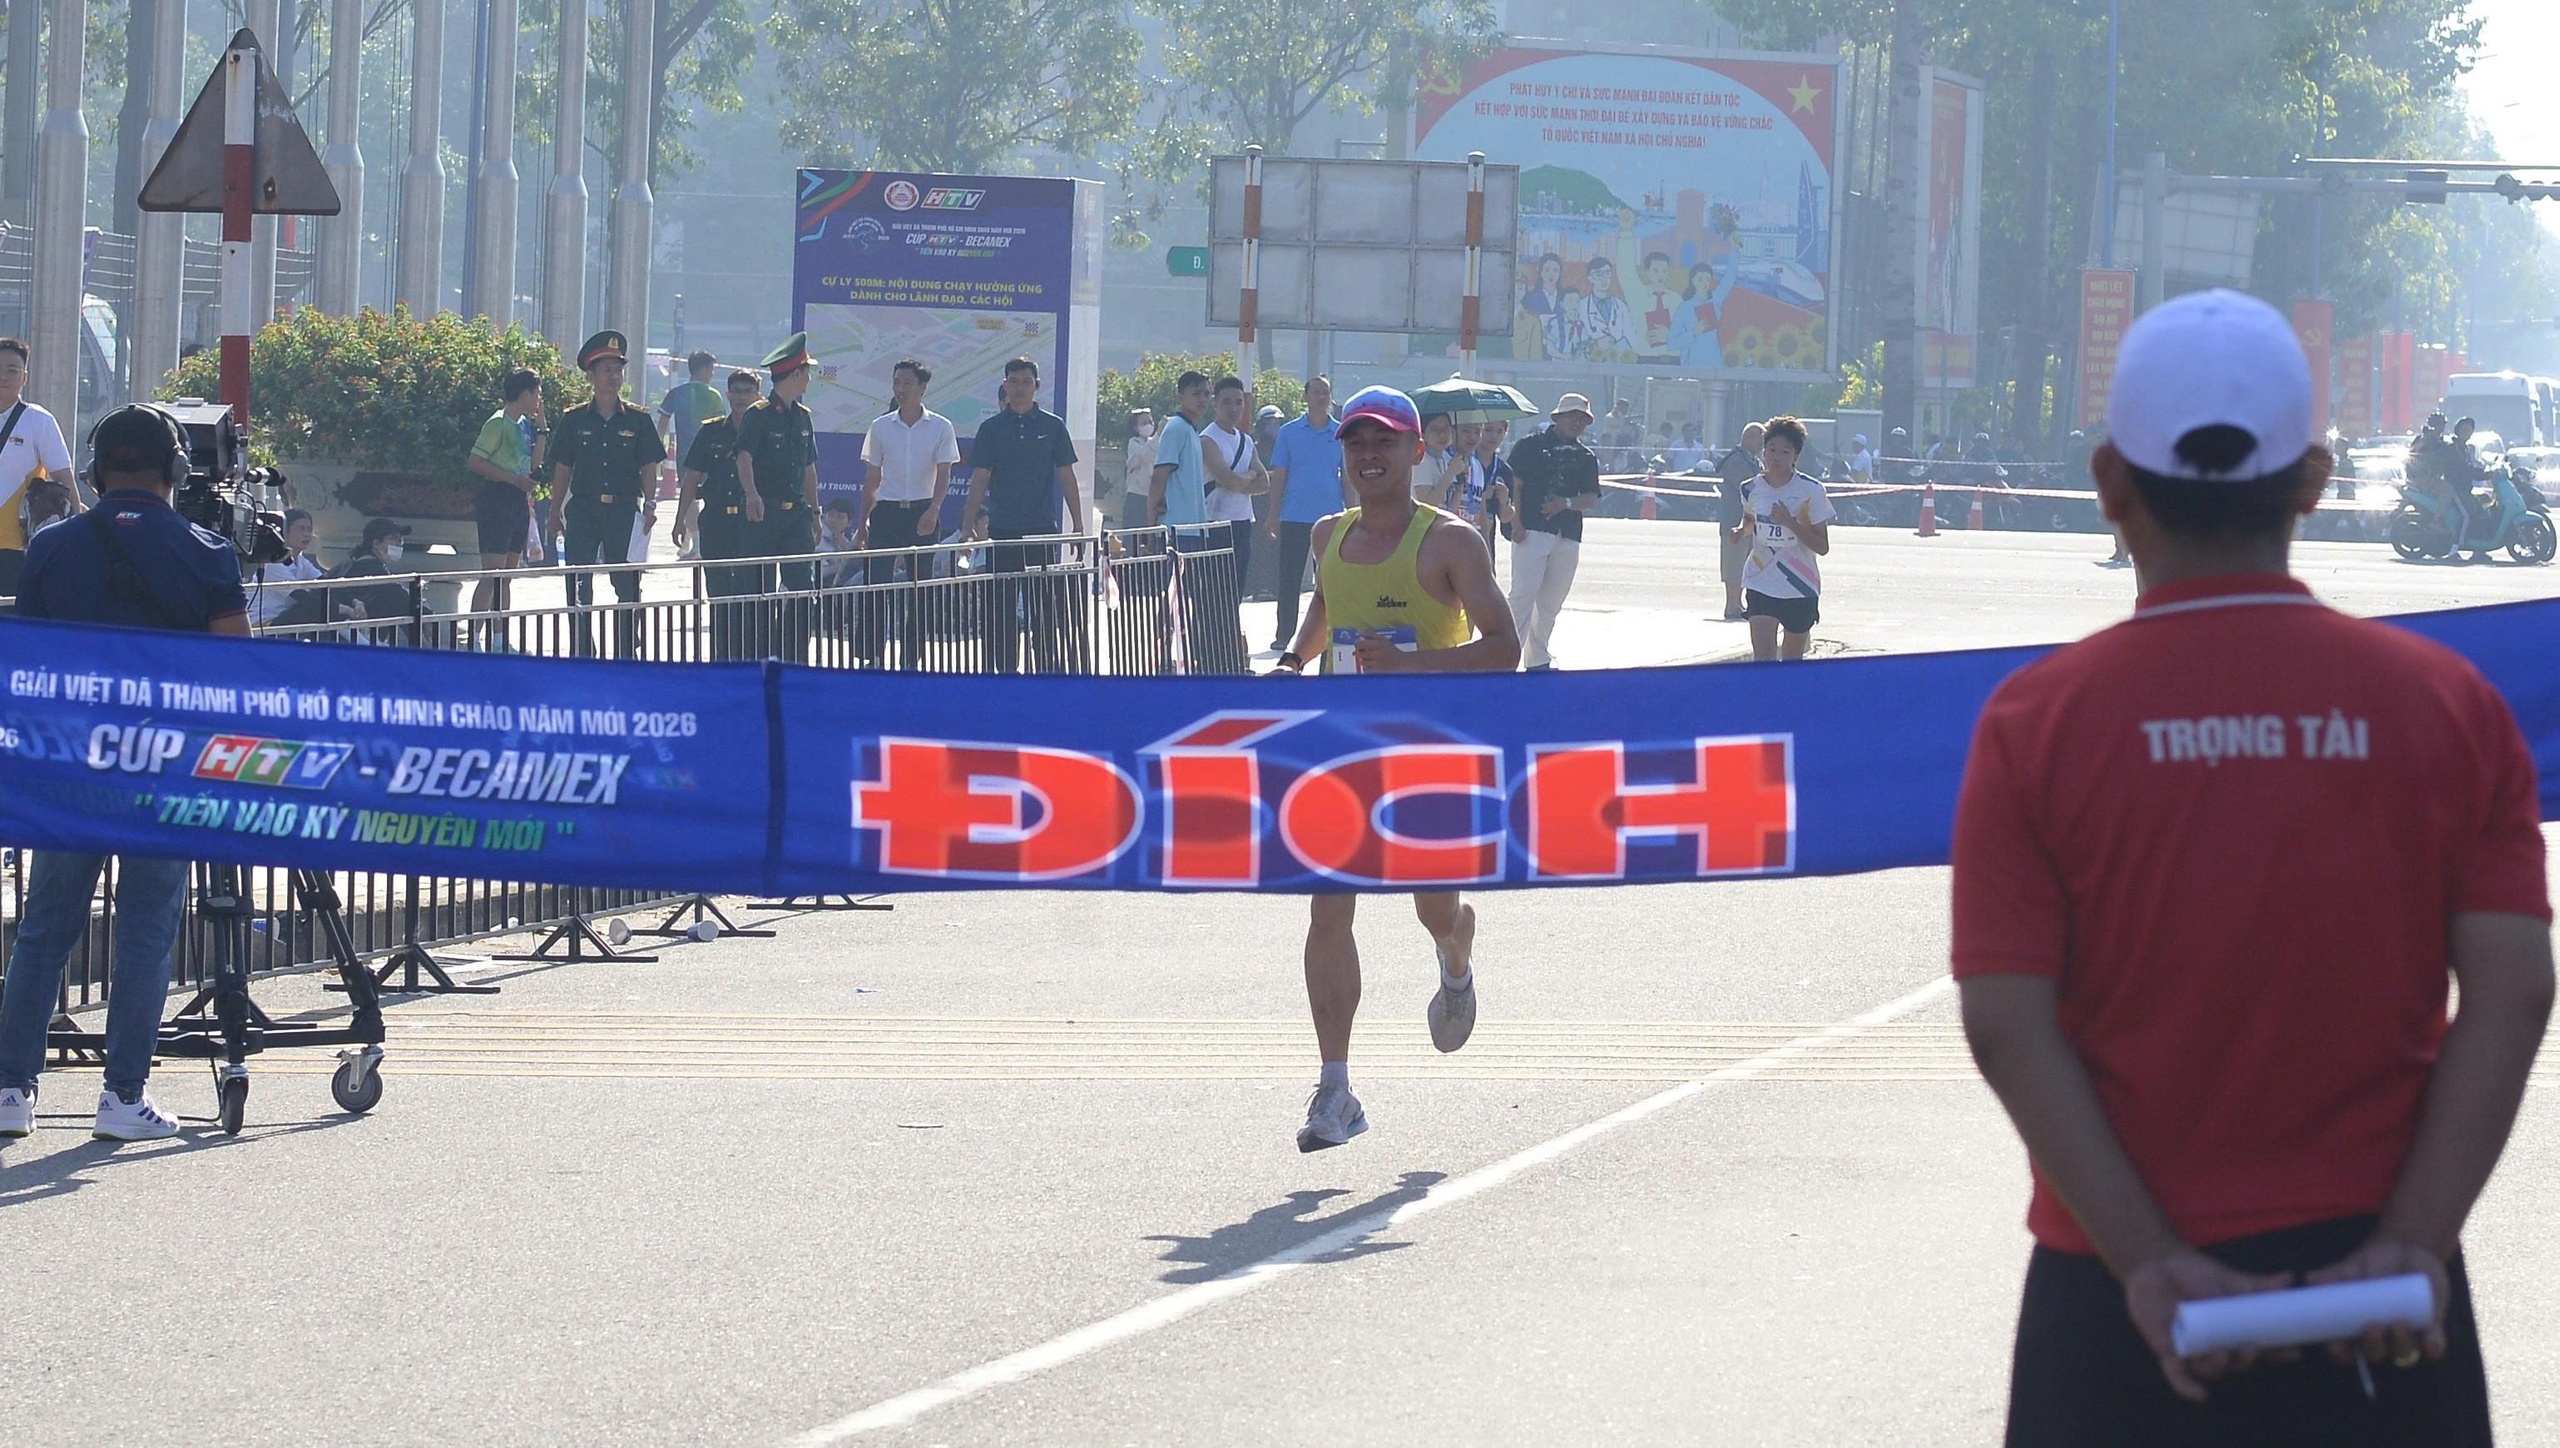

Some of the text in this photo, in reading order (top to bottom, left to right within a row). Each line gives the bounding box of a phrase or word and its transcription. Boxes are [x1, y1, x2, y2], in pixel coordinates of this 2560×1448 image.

[1535, 85, 1552, 97] HUY
[1684, 88, 1701, 105] KẾT
[1474, 99, 1491, 115] KẾT
[1601, 132, 1622, 145] NAM
[925, 191, 981, 207] HTV
[965, 235, 1012, 248] BECAMEX
[822, 276, 838, 287] CỰ
[840, 278, 852, 286] LY
[888, 278, 908, 290] NỘI
[911, 280, 941, 290] DUNG
[944, 281, 973, 293] CHẠY
[975, 280, 1015, 293] HƯỞNG
[1018, 281, 1043, 294] ỨNG
[850, 289, 881, 301] DÀNH
[885, 292, 907, 301] CHO
[909, 291, 939, 303] LÃNH
[970, 294, 991, 305] CÁC
[993, 294, 1013, 308] HỘI
[828, 482, 857, 491] TRUNG
[1769, 525, 1782, 537] 78
[10, 665, 697, 737] GIẢI VIỆT DÃ THÀNH PHỐ HỒ CHÍ MINH CHÀO NĂM MỚI 2026
[2141, 707, 2370, 768] TRỌNG TÀI
[87, 717, 186, 774] CÚP
[196, 742, 341, 781] HTV
[387, 746, 630, 805] BECAMEX
[851, 709, 1796, 888] ĐÍCH
[158, 788, 228, 828] TIẾN
[234, 796, 297, 837] VÀO
[300, 801, 349, 841] KỶ
[351, 808, 477, 849] NGUYÊN
[482, 813, 546, 851] MỚI
